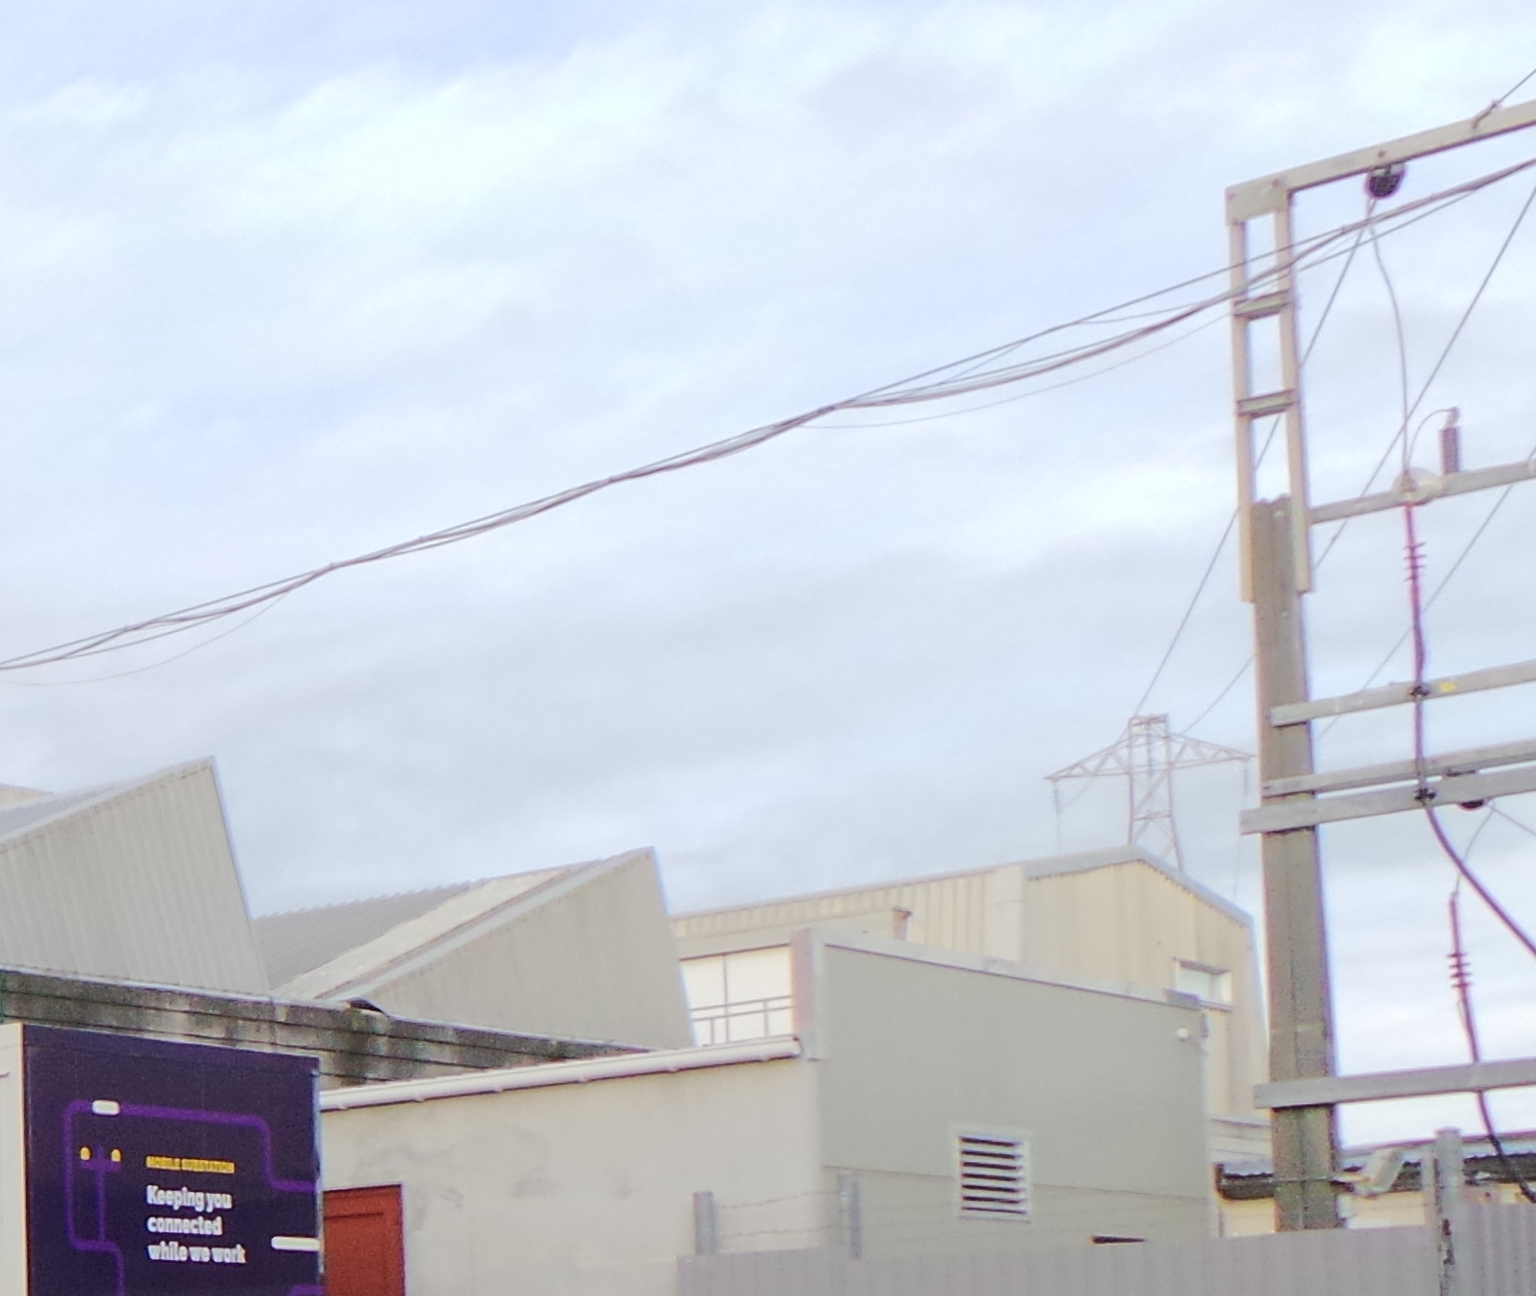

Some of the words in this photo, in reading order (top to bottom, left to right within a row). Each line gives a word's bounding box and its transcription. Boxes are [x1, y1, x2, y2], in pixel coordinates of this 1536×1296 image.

[146, 1184, 205, 1212] Keeping
[205, 1193, 233, 1213] you
[146, 1215, 223, 1236] connected
[146, 1240, 188, 1262] while
[188, 1246, 211, 1263] we
[211, 1243, 246, 1264] work
